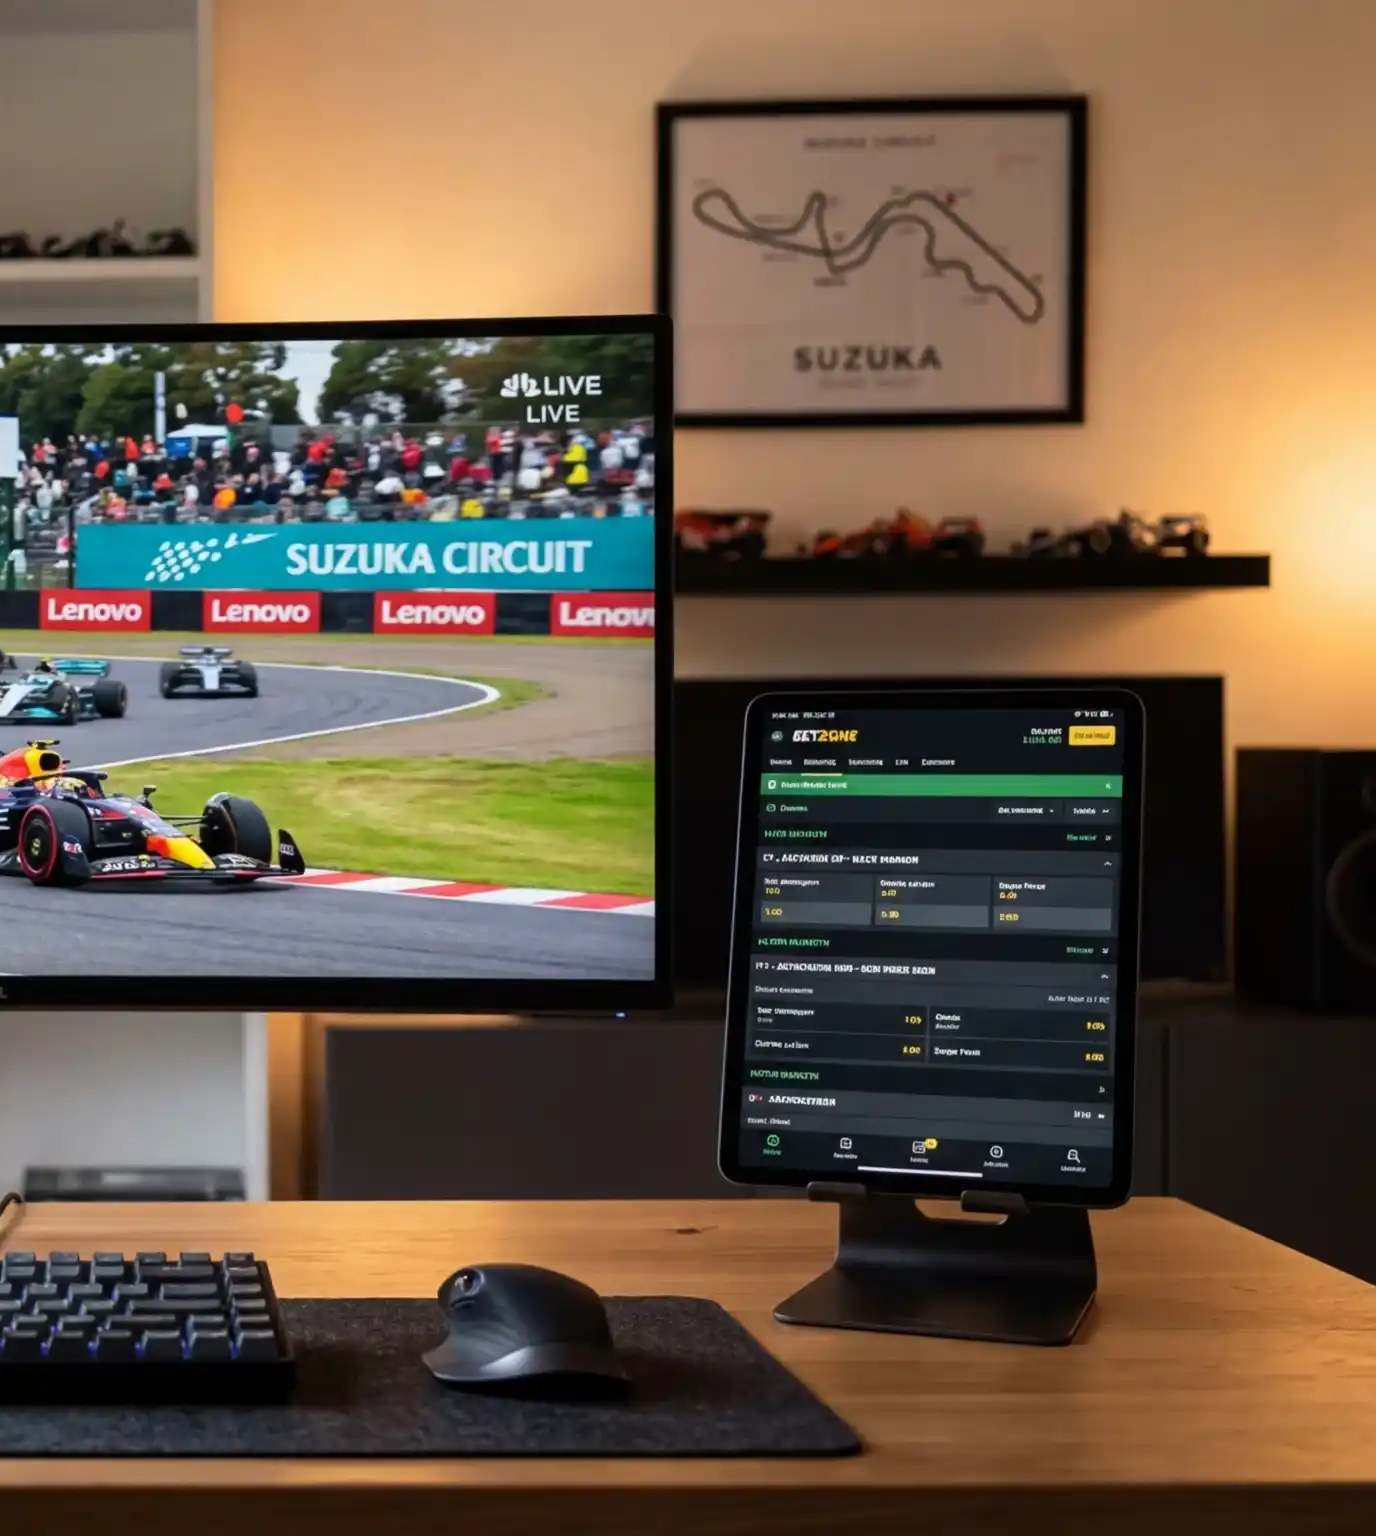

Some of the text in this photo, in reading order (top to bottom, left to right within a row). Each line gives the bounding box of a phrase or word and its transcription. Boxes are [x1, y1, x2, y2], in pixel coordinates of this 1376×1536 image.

[793, 345, 943, 372] SUZUKA
[543, 375, 602, 396] LIVE
[526, 404, 580, 424] LIVE
[286, 540, 593, 576] SUZUKA CIRCUIT
[47, 598, 143, 622] Lenovo
[211, 599, 311, 623] Lenovo
[381, 600, 486, 625] Lenovo
